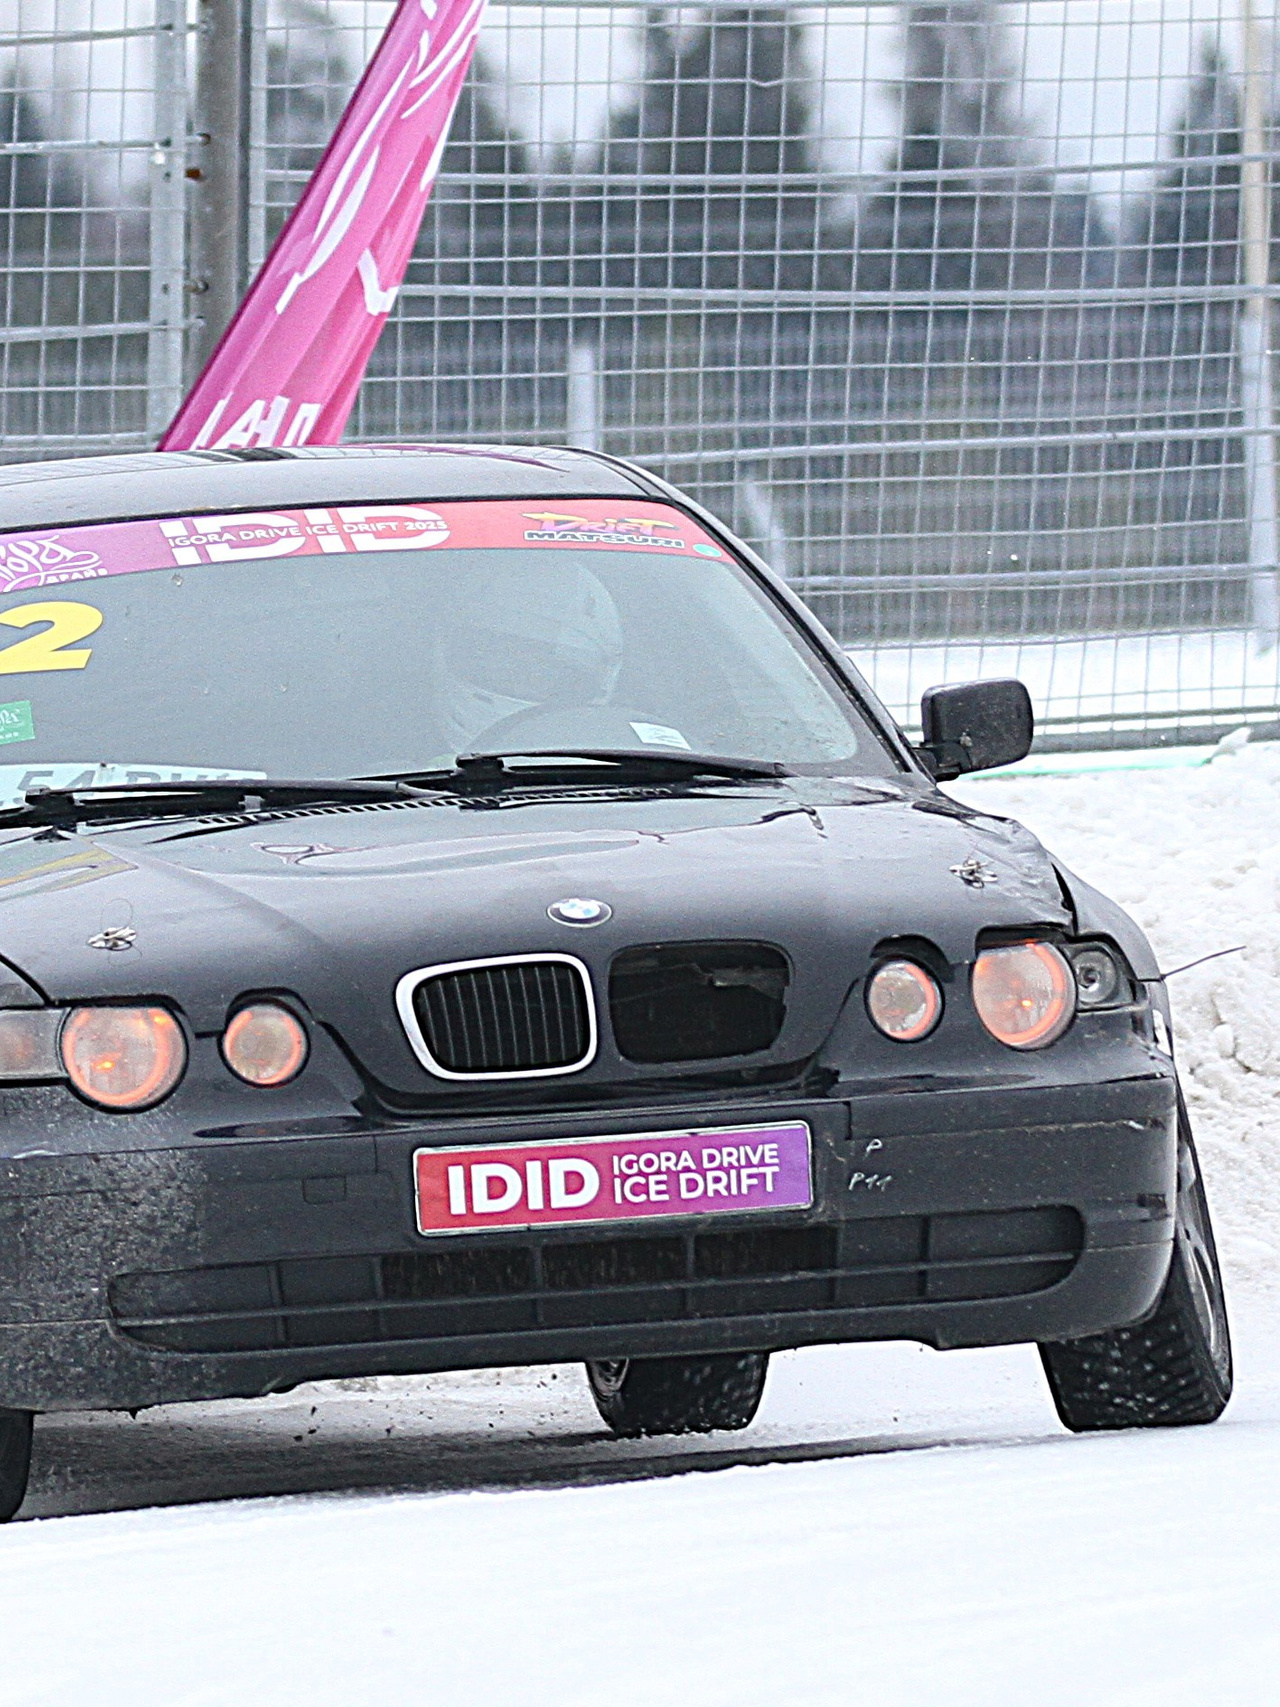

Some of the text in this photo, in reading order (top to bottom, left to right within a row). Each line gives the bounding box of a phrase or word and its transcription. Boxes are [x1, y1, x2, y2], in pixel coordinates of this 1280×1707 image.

[159, 505, 451, 566] IDID
[169, 520, 448, 548] IGORA DRIVE ICE DRIFT 2025
[524, 530, 685, 548] MATSURI
[612, 1143, 779, 1175] IGORA DRIVE
[448, 1157, 600, 1216] IDID
[614, 1166, 781, 1204] ICE DRIFT
